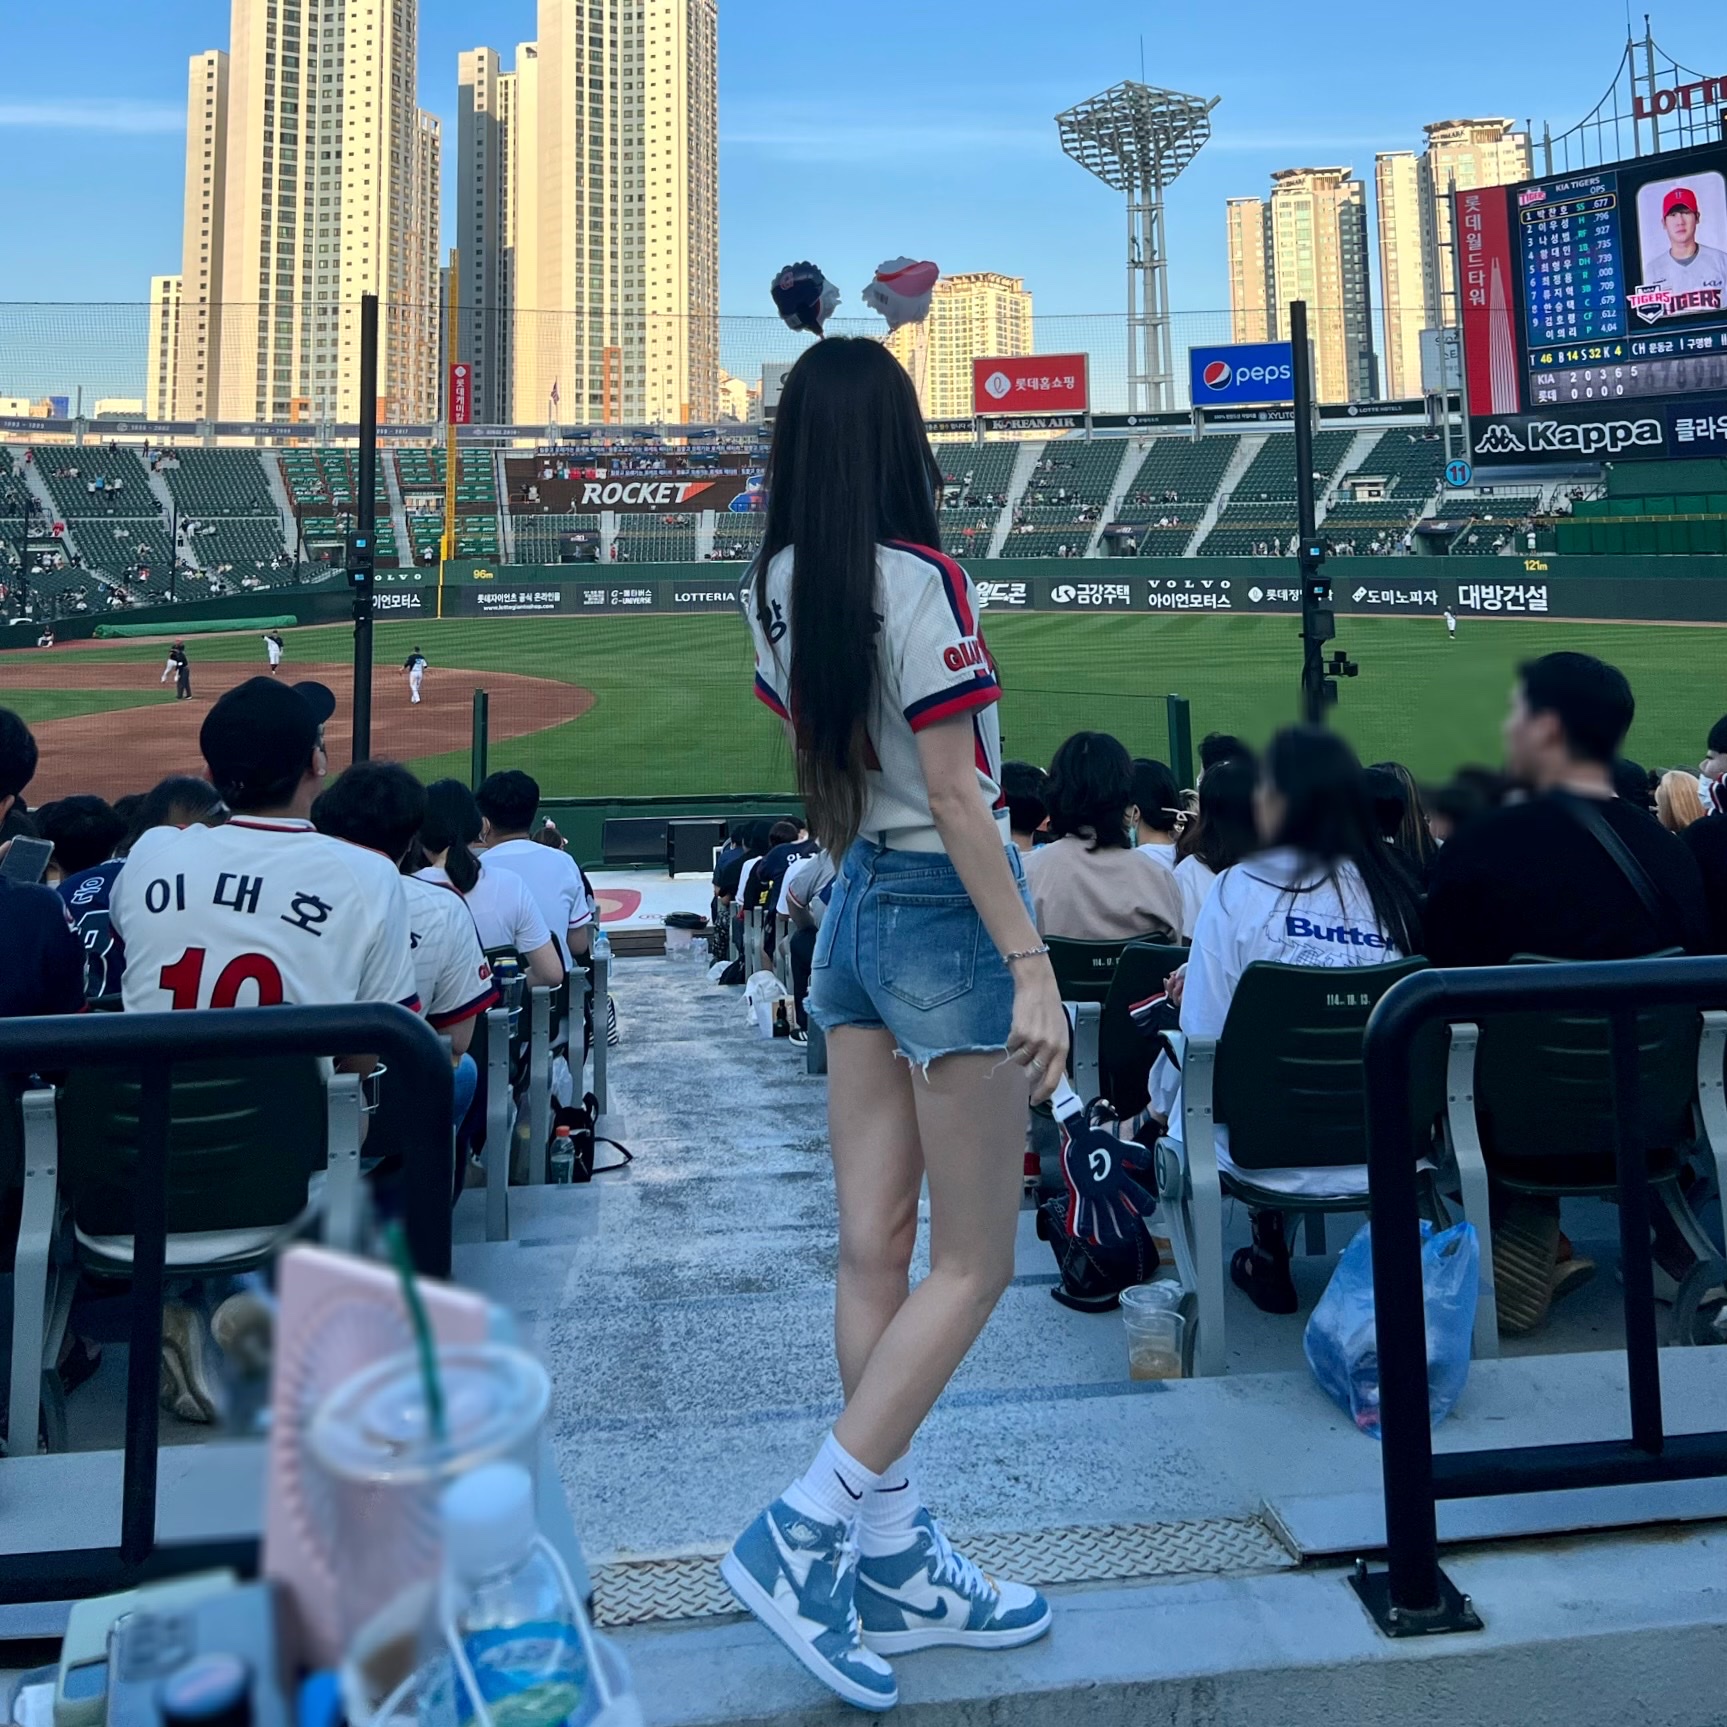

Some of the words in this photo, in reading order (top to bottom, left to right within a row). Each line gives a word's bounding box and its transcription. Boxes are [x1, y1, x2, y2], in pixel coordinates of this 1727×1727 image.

[1555, 183, 1570, 192] KIA
[1570, 176, 1601, 189] TIGERS
[1590, 184, 1606, 194] OPS
[1526, 212, 1532, 220] 1
[1527, 225, 1533, 233] 2
[1528, 238, 1533, 247] 3
[1464, 194, 1486, 306] 롯데월드타워
[1528, 251, 1534, 260] 4
[1529, 265, 1535, 274] 5
[1530, 278, 1536, 287] 6
[1531, 291, 1537, 300] 7
[1630, 292, 1670, 306] TIGERS
[1531, 305, 1538, 314] 8
[1532, 318, 1539, 327] 9
[1631, 342, 1646, 355] CH
[1529, 354, 1536, 366] T
[1540, 353, 1553, 364] 46
[1558, 351, 1565, 363] B
[1566, 350, 1579, 362] 14
[1581, 349, 1587, 360] S
[1588, 347, 1601, 359] 32
[1603, 346, 1610, 358] K
[1614, 345, 1622, 356] 4
[1236, 365, 1291, 386] peps
[1537, 373, 1555, 385] KIA
[1570, 371, 1577, 383] 2
[1584, 370, 1591, 381] 0
[1600, 369, 1607, 380] 3
[1614, 367, 1622, 378] 6
[1630, 366, 1638, 377] 5
[1015, 375, 1075, 392] 롯데홈쇼핑
[1538, 389, 1557, 403] 롯데
[1571, 388, 1578, 399] 0
[1586, 387, 1593, 398] 0
[1601, 386, 1608, 396] 0
[1616, 384, 1623, 395] 0
[1267, 411, 1295, 420] XYLITO
[992, 418, 1046, 430] KOREAN
[1048, 417, 1076, 428] AIR
[1528, 418, 1663, 454] Kappa
[1449, 465, 1466, 482] 11
[581, 482, 692, 505] ROCKET
[1524, 560, 1548, 571] 121m
[374, 573, 422, 581] OLVO
[473, 569, 494, 580] 96m
[1148, 580, 1232, 589] VOLVO
[372, 593, 421, 609] 이언모터스
[674, 592, 735, 602] LOTTERIA
[1076, 583, 1131, 606] 금강주택
[1148, 592, 1232, 609] 아이언모터스
[1367, 589, 1438, 606] 도미노피자
[1458, 584, 1548, 612] 대방건설
[144, 872, 334, 937] 이대호
